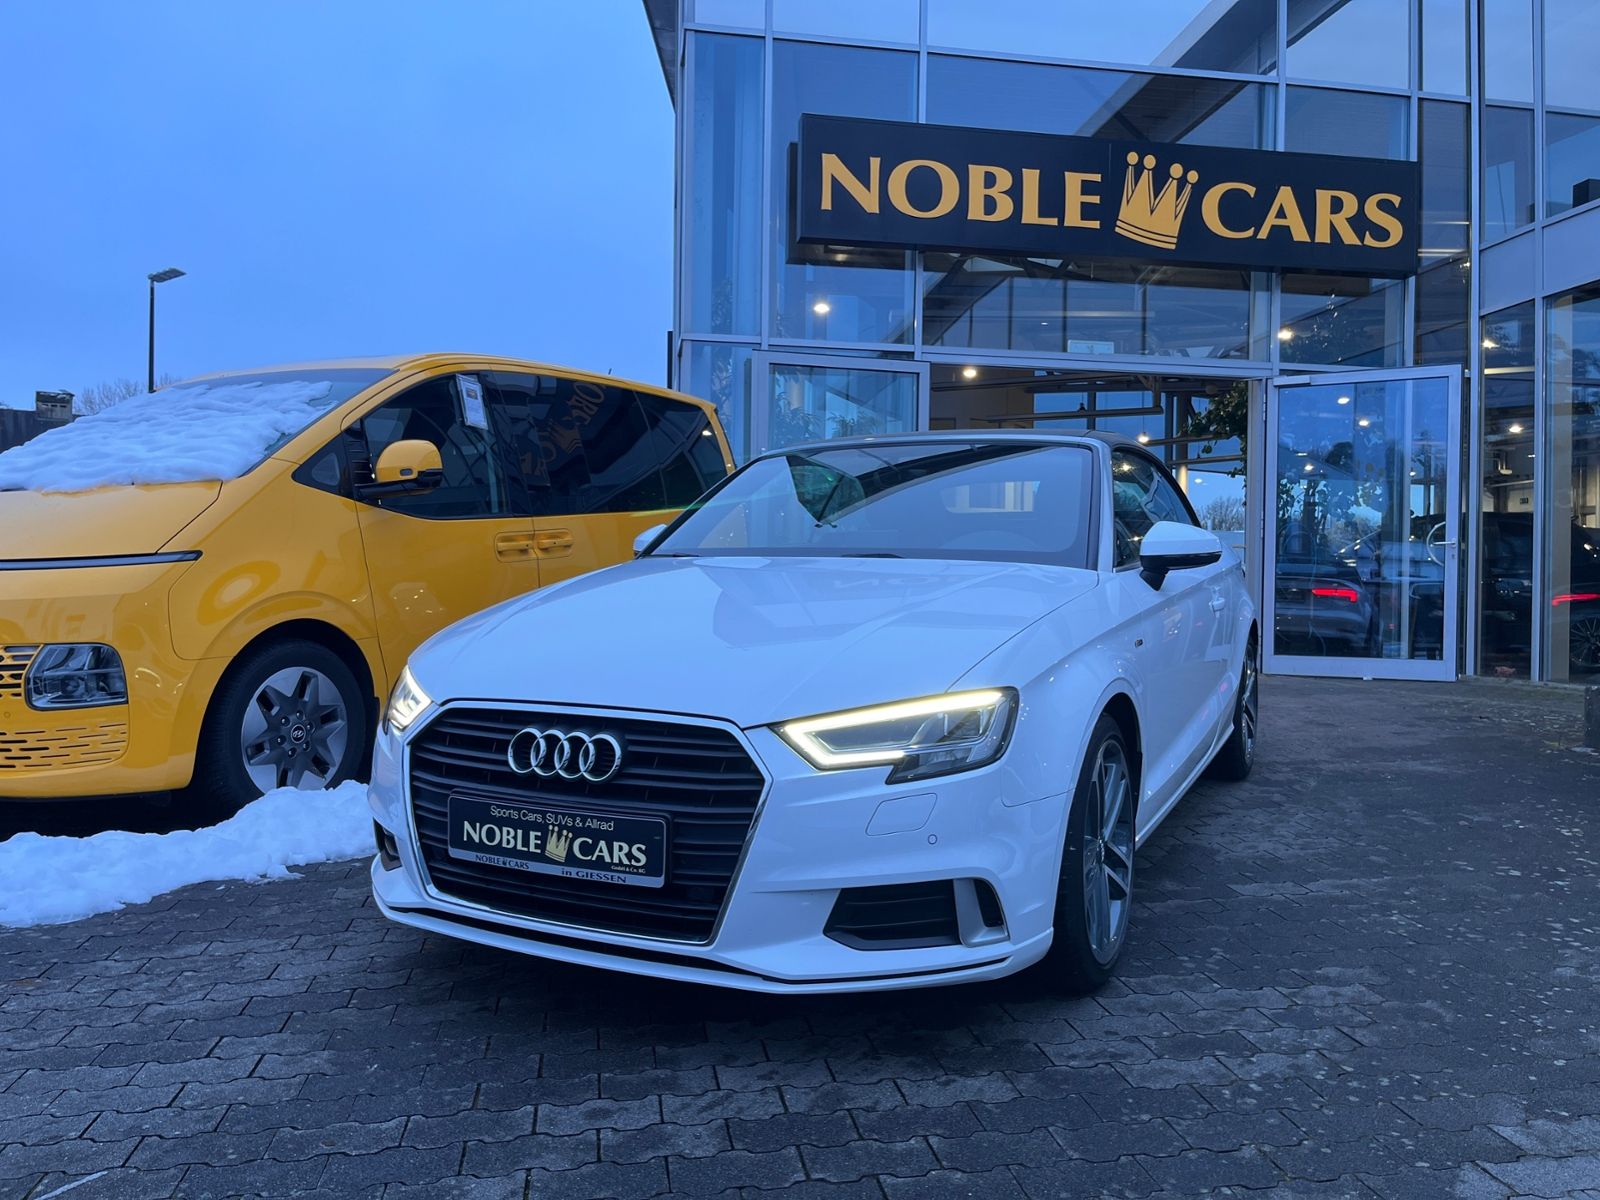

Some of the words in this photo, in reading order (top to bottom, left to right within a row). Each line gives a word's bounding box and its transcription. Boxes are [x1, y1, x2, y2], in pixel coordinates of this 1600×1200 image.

[820, 152, 1102, 229] NOBLE
[1200, 181, 1404, 248] CARS
[490, 805, 519, 819] Sports
[520, 810, 545, 823] Cars,
[546, 813, 573, 826] SUVs
[575, 817, 582, 827] &
[585, 818, 614, 831] Allrad
[463, 820, 541, 853] NOBLE
[573, 837, 647, 867] CARS
[475, 854, 500, 865] NOBLE
[508, 861, 529, 870] CARS
[561, 868, 572, 876] in
[576, 870, 626, 883] GIESSEN
